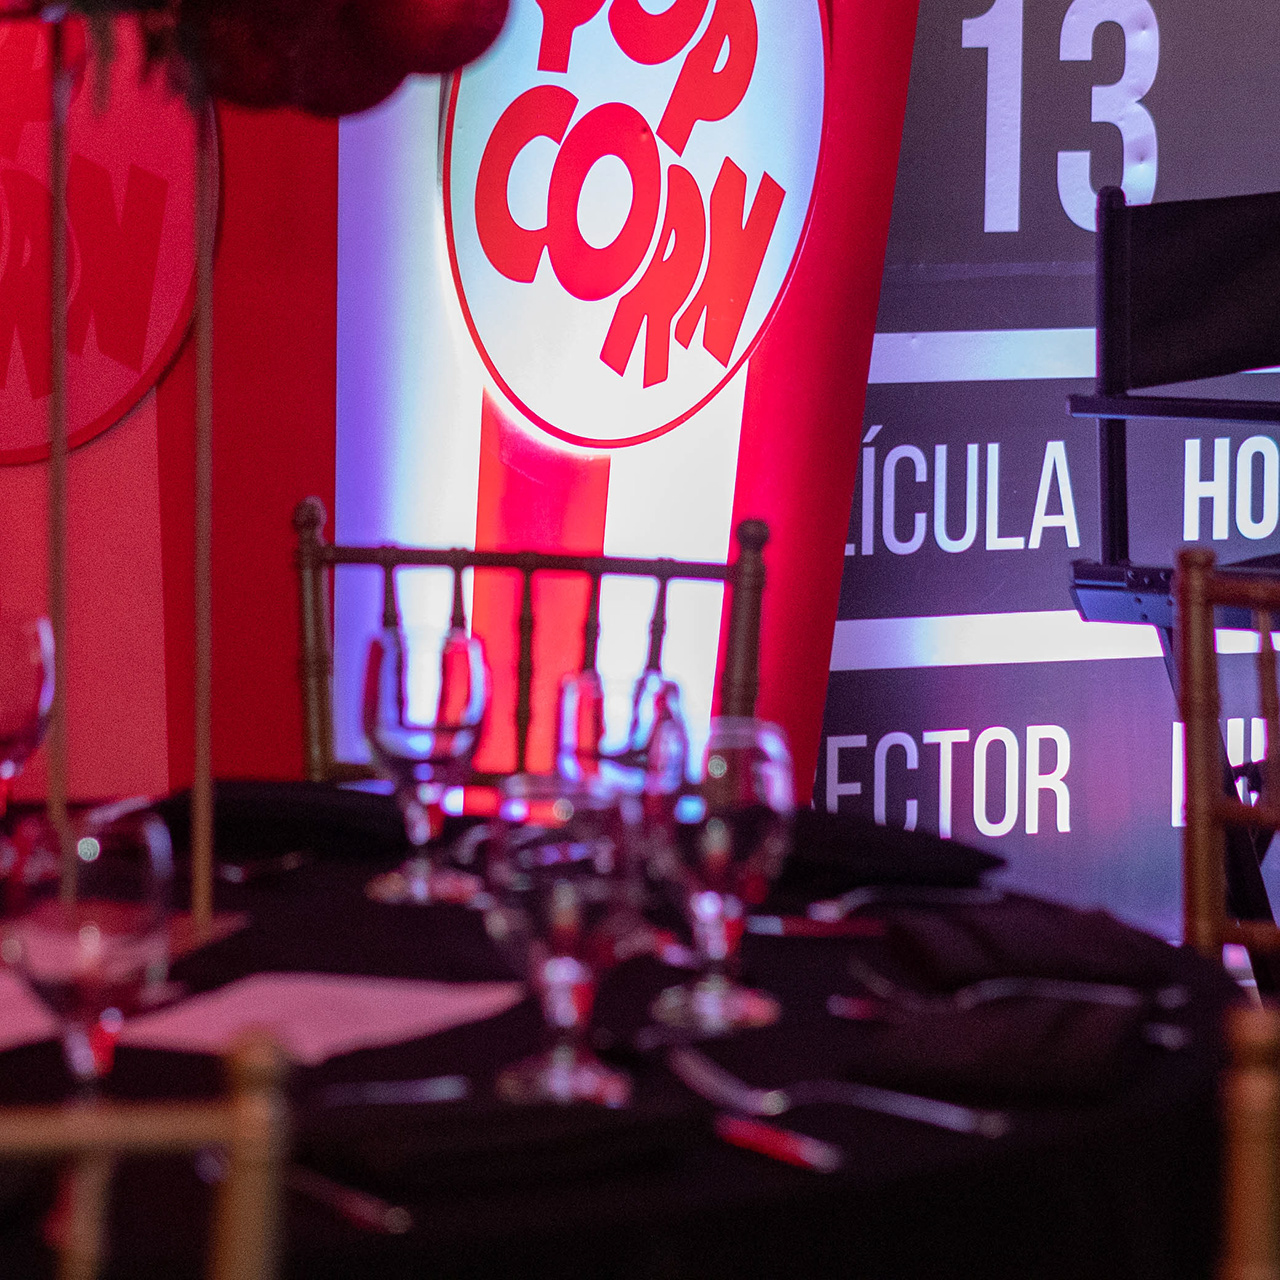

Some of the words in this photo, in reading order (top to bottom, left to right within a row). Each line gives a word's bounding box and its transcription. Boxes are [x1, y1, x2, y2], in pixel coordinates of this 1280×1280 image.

[474, 84, 786, 389] CORN
[844, 424, 1080, 556] ÍCULA
[811, 724, 1071, 839] ECTOR
